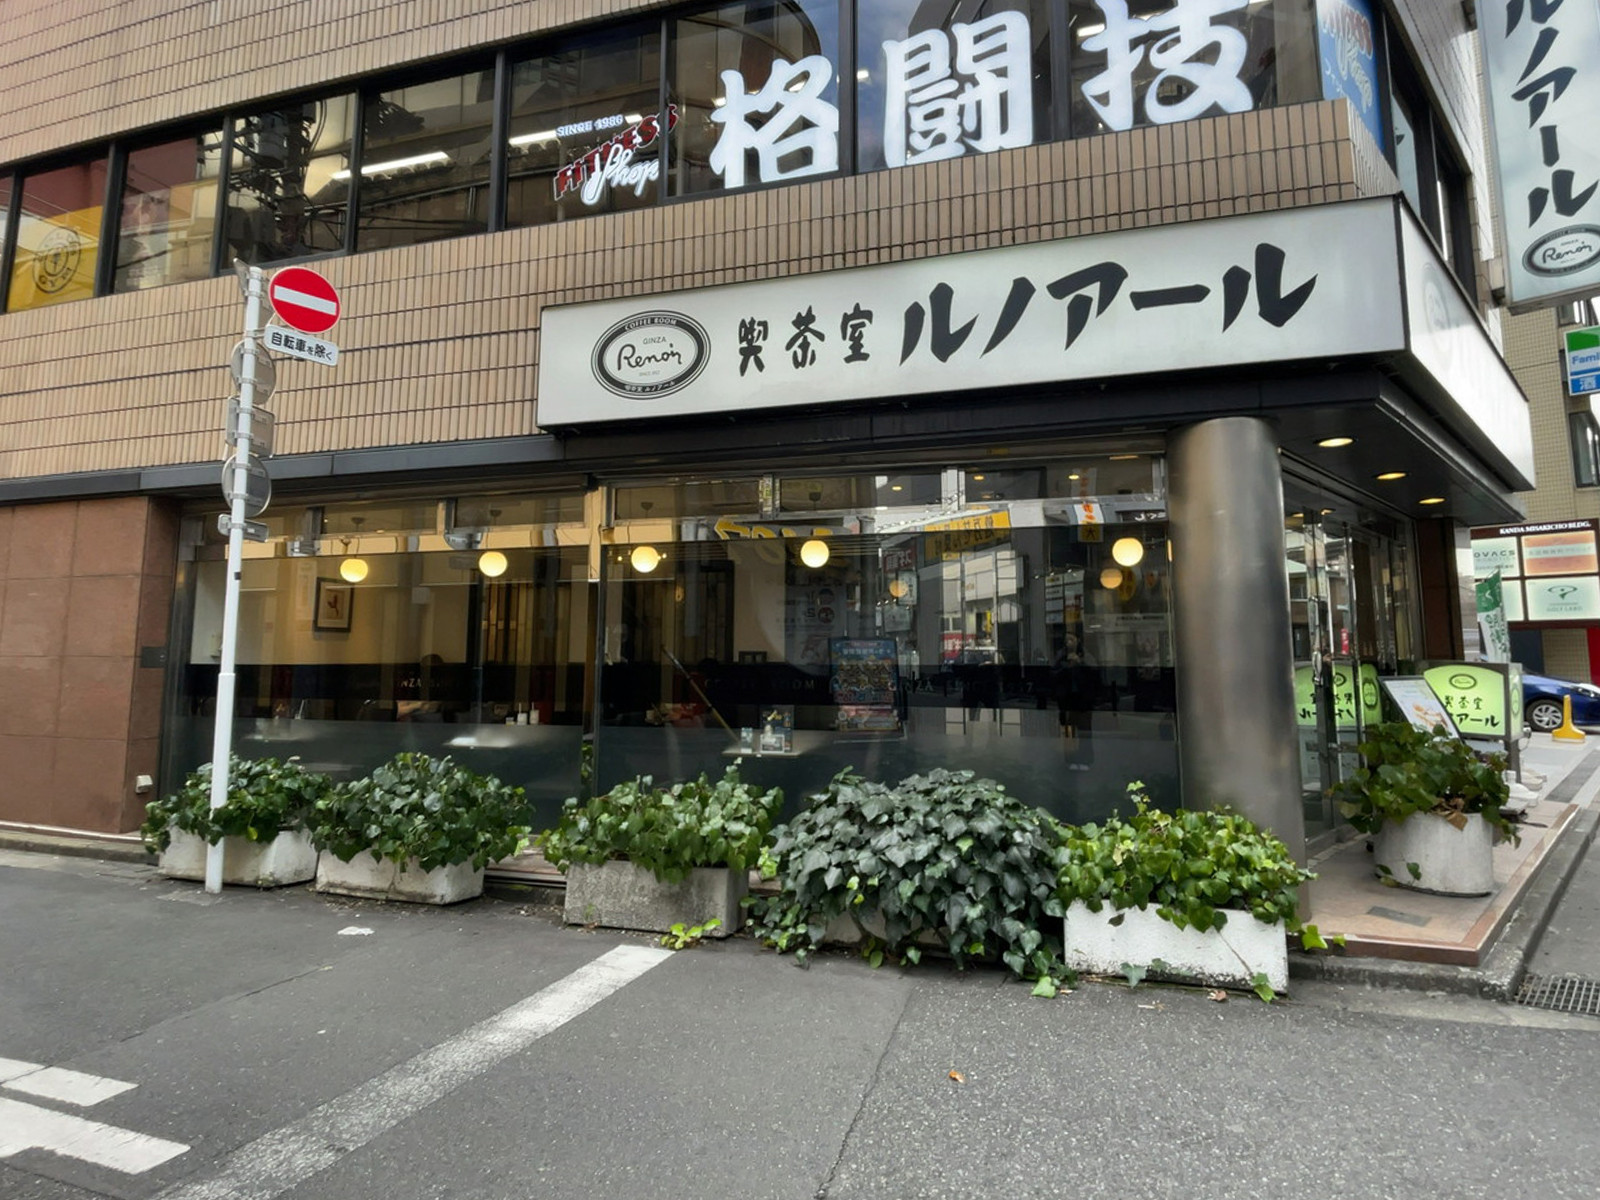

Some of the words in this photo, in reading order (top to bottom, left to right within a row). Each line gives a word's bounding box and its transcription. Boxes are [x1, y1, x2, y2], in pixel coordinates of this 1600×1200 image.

[709, 0, 1254, 189] 格闘技
[581, 144, 659, 205] Shop
[654, 317, 676, 325] ROOM
[738, 303, 874, 377] 喫茶室
[900, 243, 1318, 366] ルノアール
[271, 331, 333, 361] 自転車を除く
[642, 336, 667, 345] GINZA
[617, 343, 682, 371] Renoir
[1499, 526, 1525, 534] KANDA
[1526, 523, 1567, 532] MISAKICHO
[1450, 712, 1500, 727] アール
